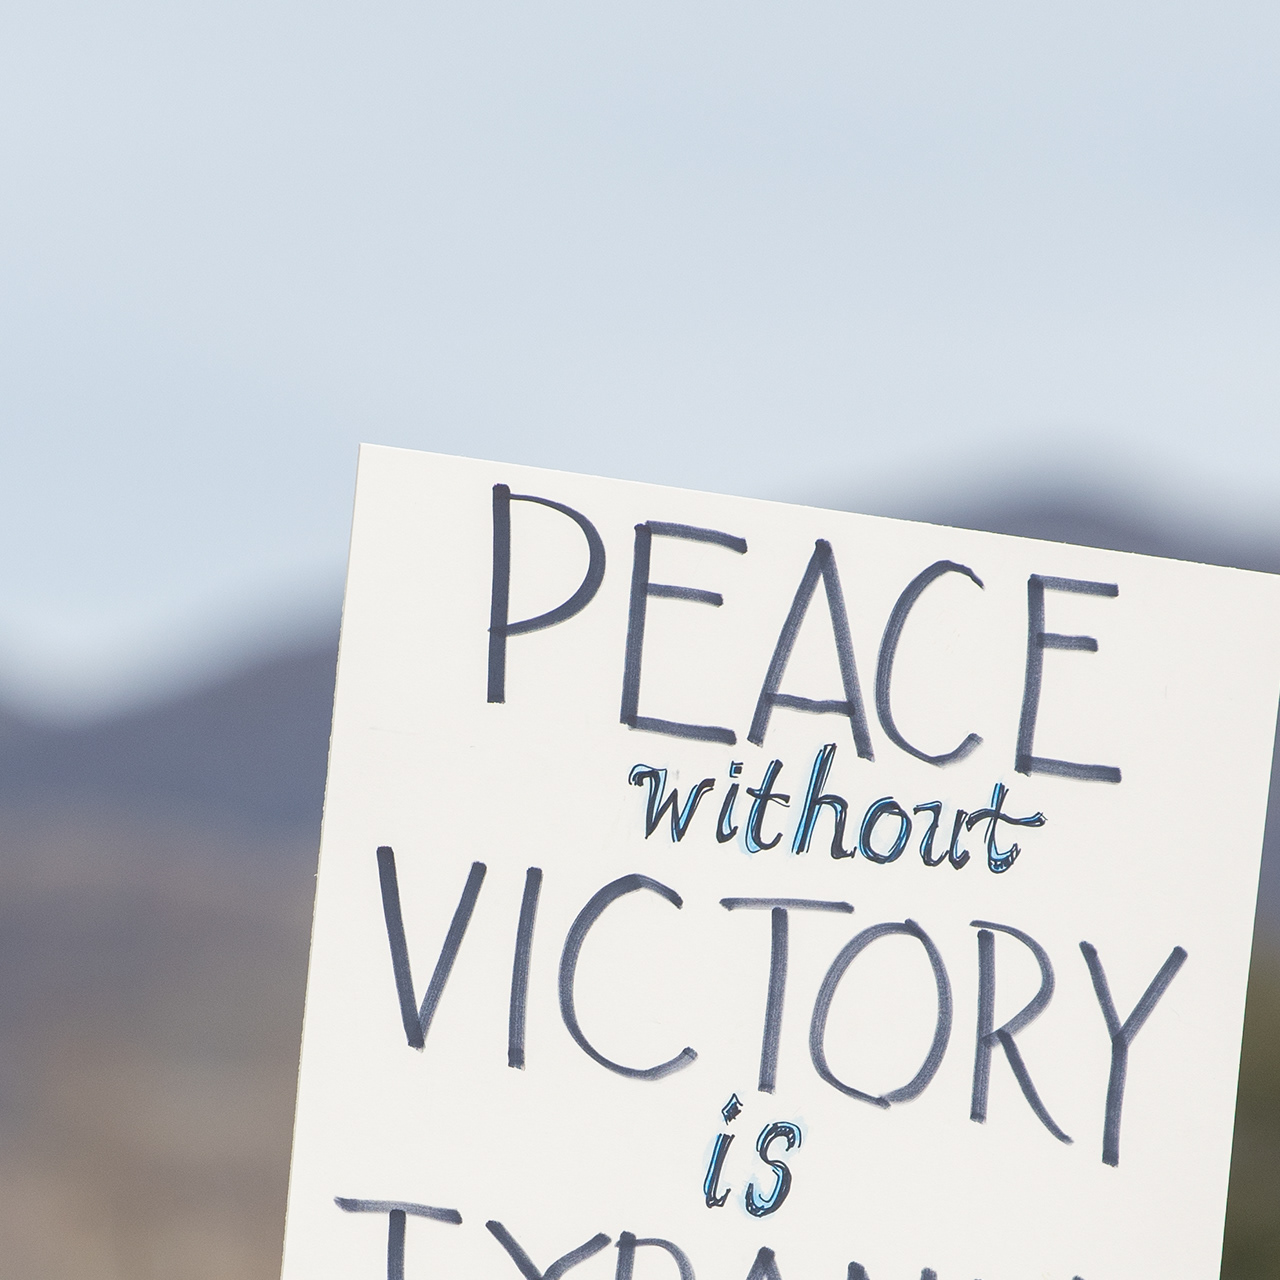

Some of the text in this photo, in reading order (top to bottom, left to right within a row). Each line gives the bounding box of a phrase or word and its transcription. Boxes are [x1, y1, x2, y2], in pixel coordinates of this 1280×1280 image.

[487, 484, 1121, 783] PEACE
[628, 739, 1047, 874] without
[377, 846, 1187, 1167] VICTORY
[704, 1093, 801, 1218] is
